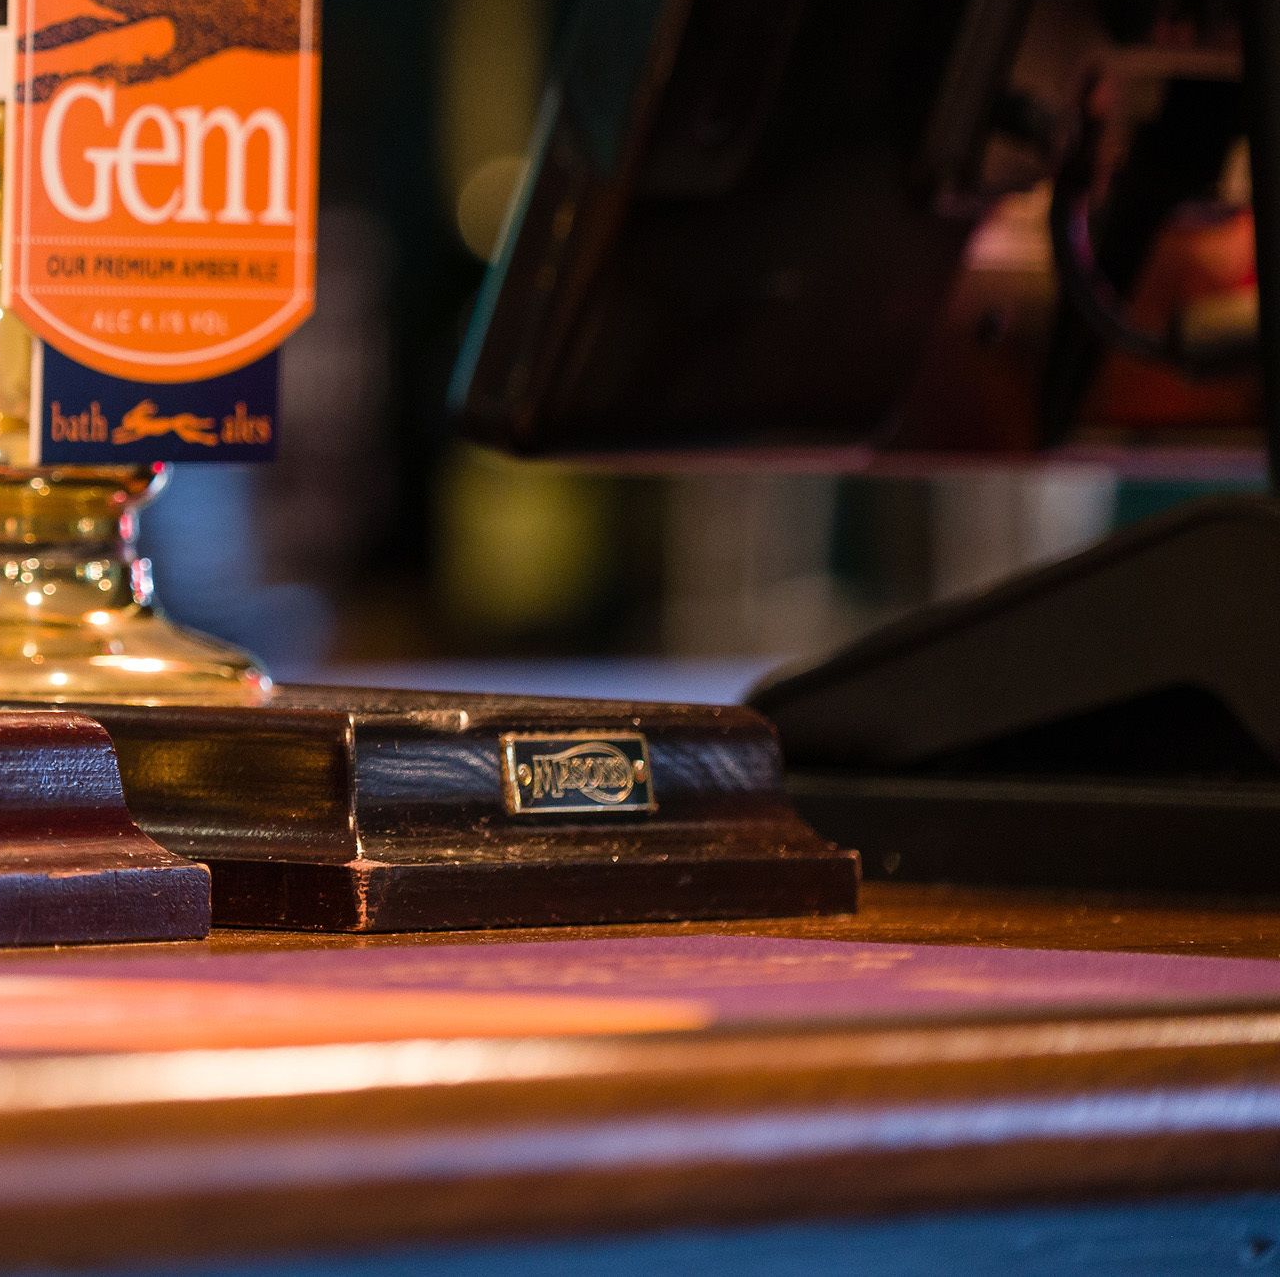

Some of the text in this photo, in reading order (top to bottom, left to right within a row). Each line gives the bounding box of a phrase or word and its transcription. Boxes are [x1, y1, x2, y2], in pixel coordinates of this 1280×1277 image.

[41, 82, 294, 225] Gem
[46, 254, 280, 284] OUR PREMIUM AMBER ALE
[50, 400, 273, 444] bath ales
